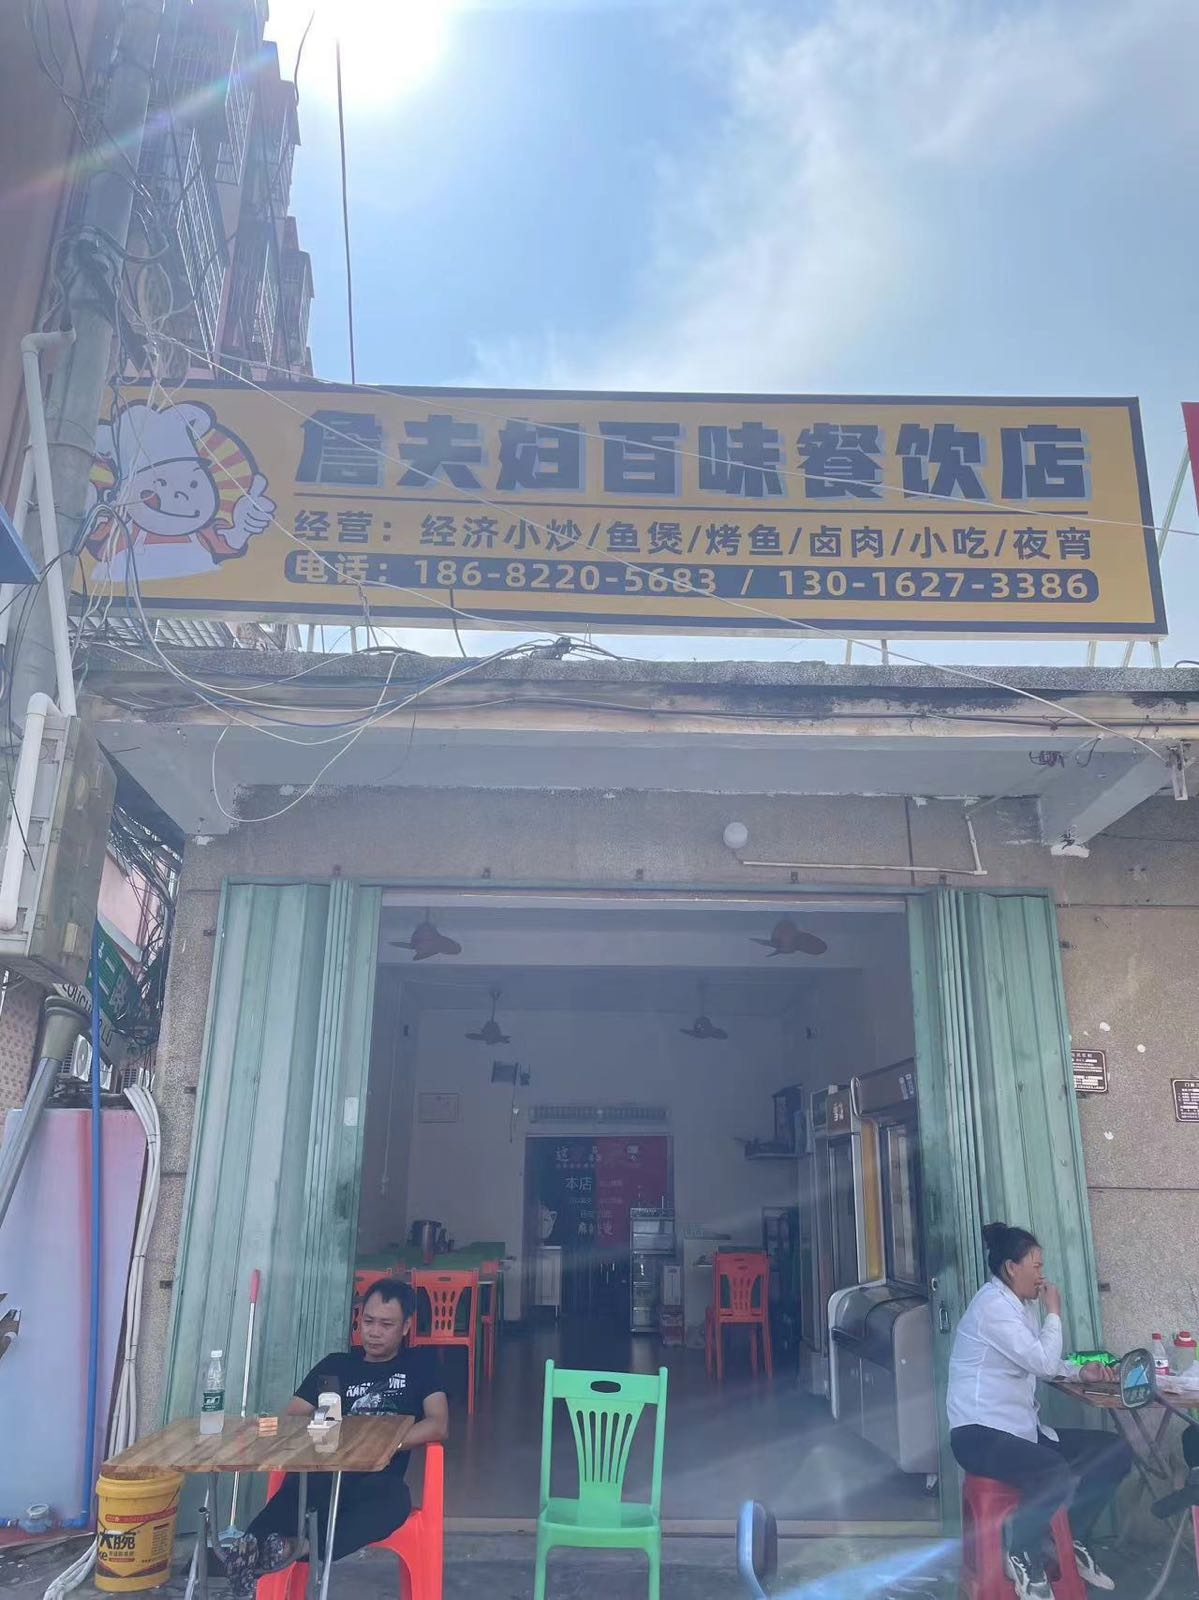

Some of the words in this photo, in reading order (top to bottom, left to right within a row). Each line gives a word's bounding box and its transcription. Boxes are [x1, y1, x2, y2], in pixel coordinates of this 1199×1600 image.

[294, 409, 1092, 499] 詹夫妇百味餐饮店
[779, 569, 1089, 599] 130-1627-3386
